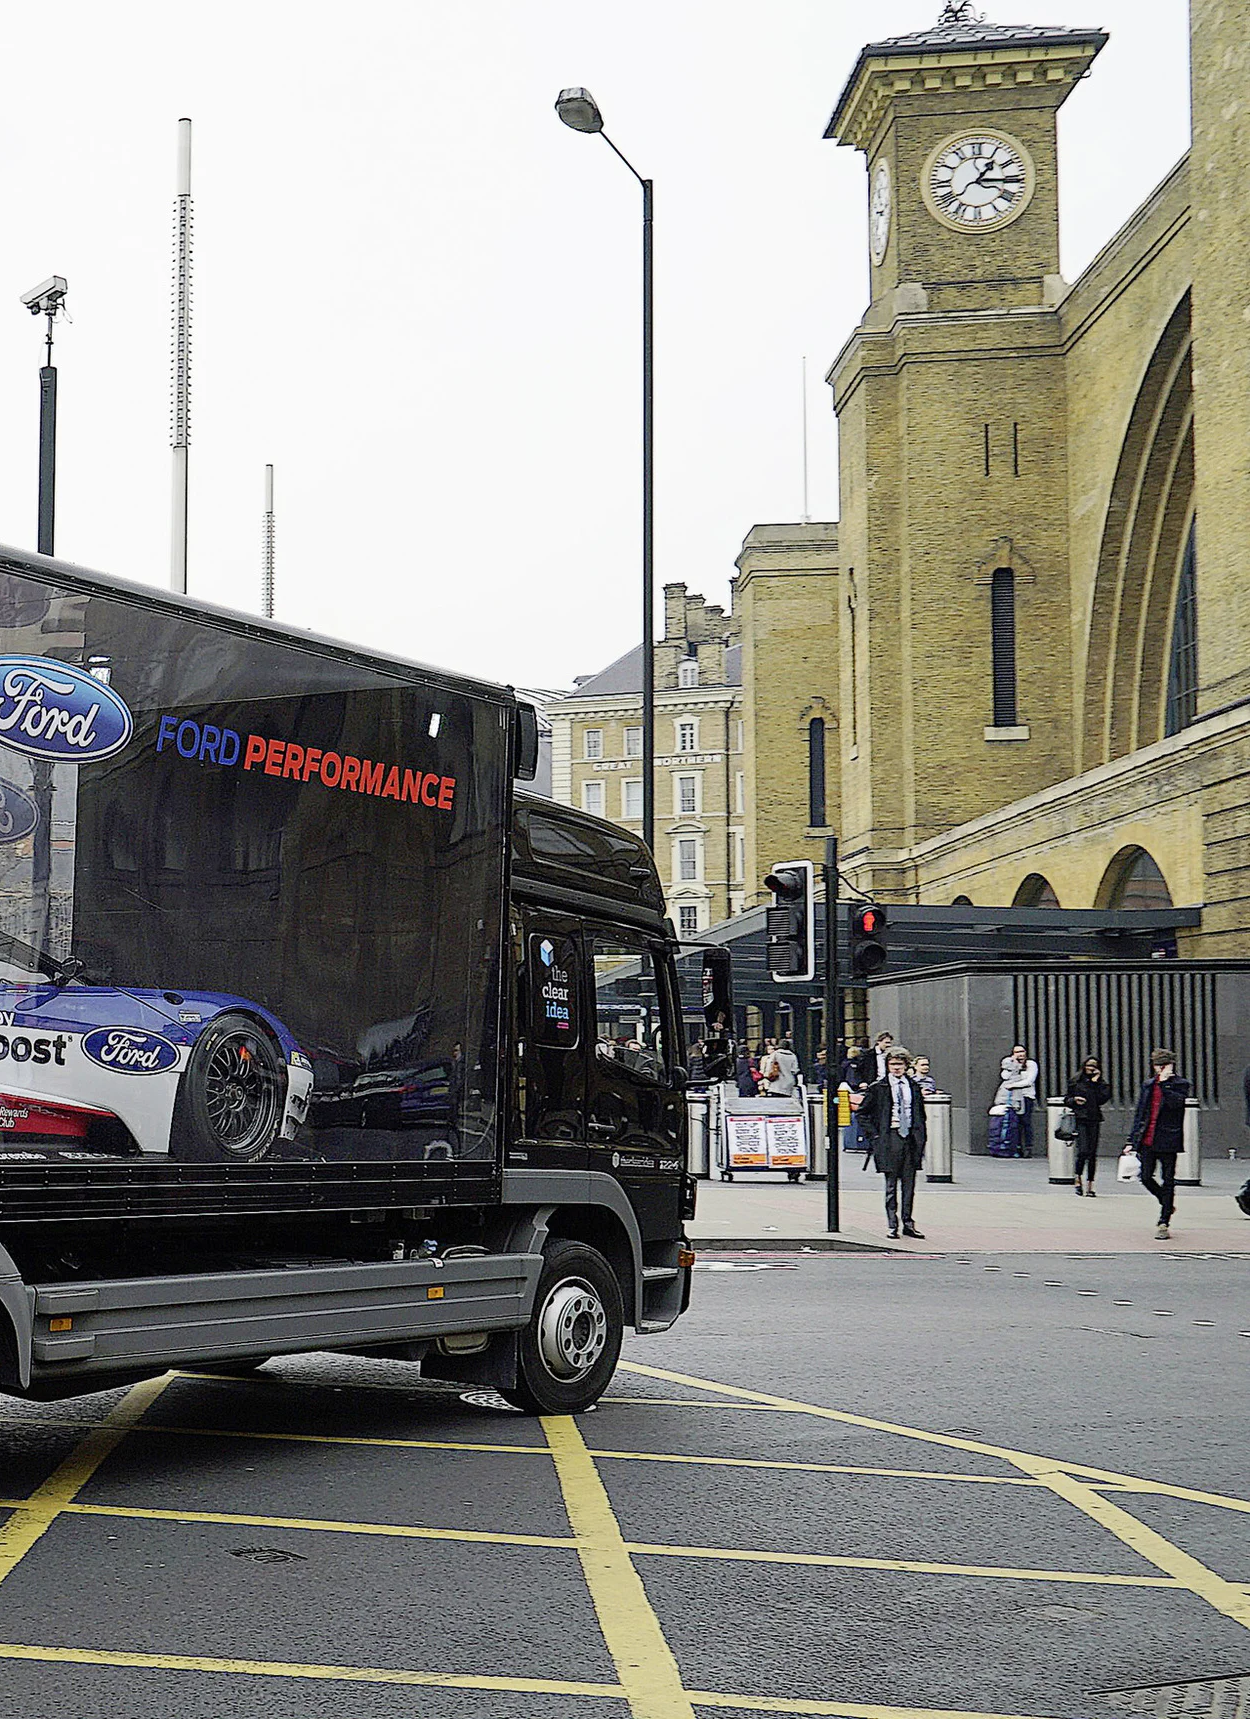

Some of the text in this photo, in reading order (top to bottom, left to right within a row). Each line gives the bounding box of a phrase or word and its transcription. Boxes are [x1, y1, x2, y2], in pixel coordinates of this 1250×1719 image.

[156, 715, 457, 811] FORD PERFORMANCE
[593, 761, 634, 772] GREAT
[551, 965, 568, 983] the
[542, 982, 569, 1001] clear
[546, 1001, 570, 1020] idea
[101, 1031, 162, 1069] Ford
[0, 1106, 29, 1119] Rewards
